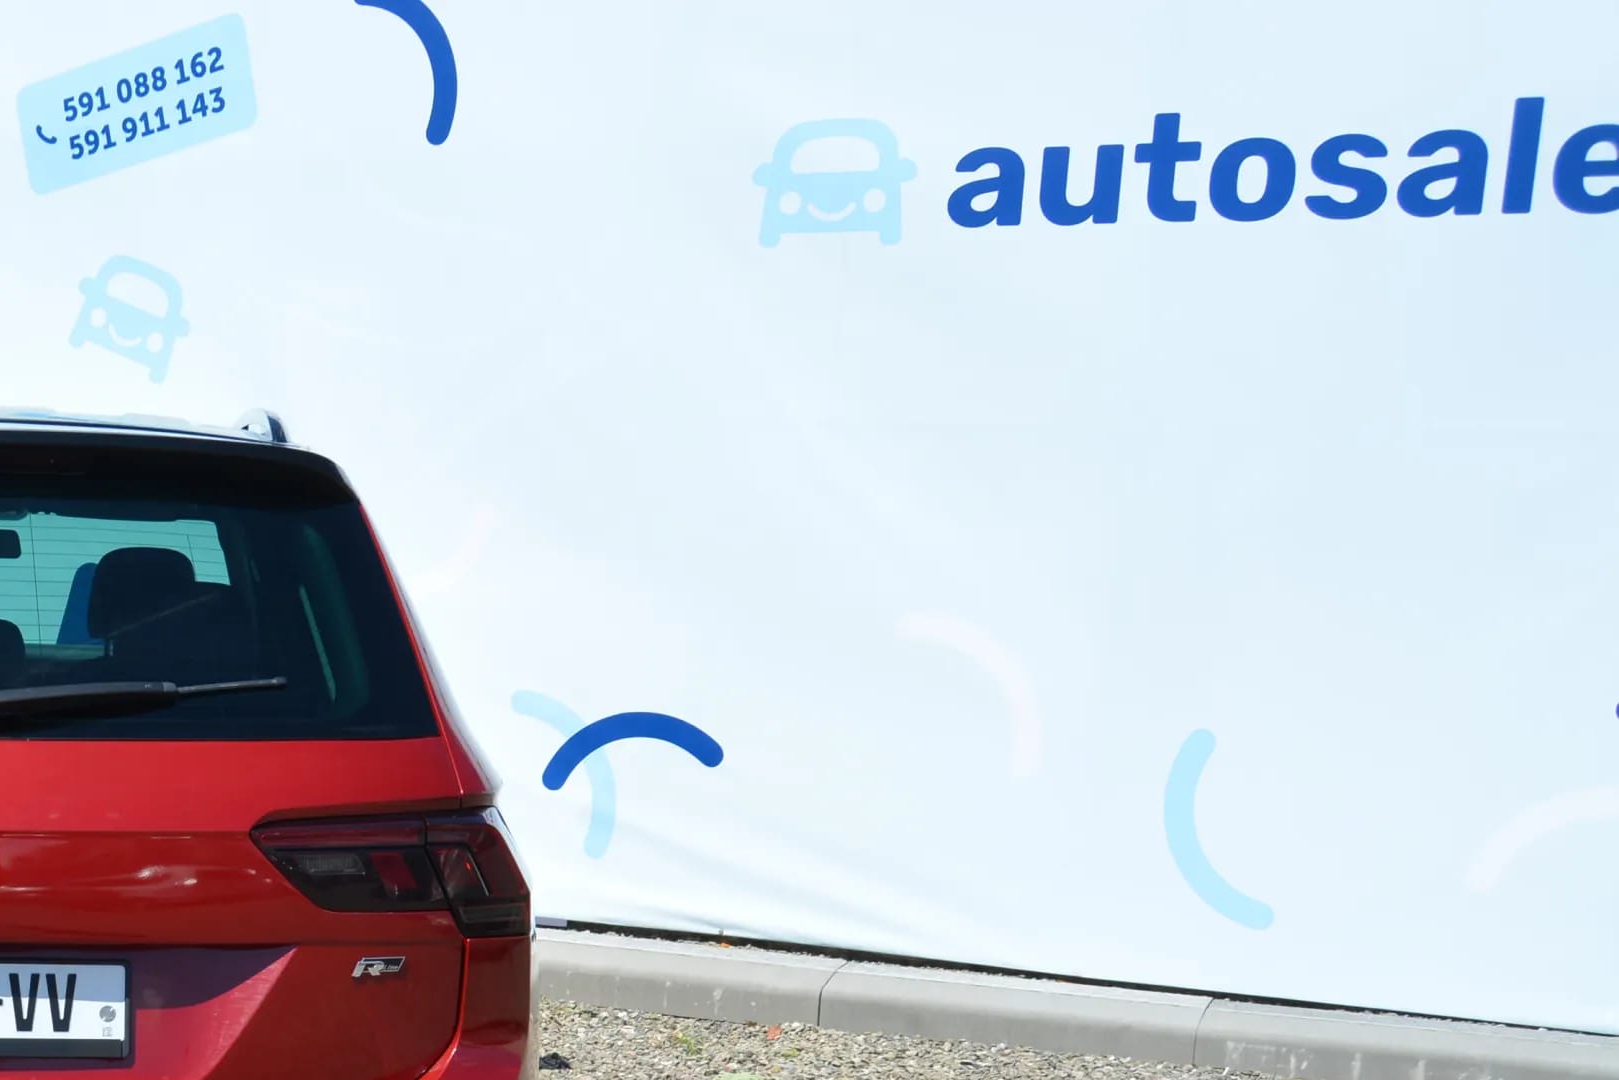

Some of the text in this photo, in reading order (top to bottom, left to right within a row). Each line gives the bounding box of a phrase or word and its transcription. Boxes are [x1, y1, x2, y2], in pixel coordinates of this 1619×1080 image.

[63, 46, 224, 122] 591 088 162
[69, 86, 225, 160] 591 911 143
[947, 96, 1619, 228] autosale
